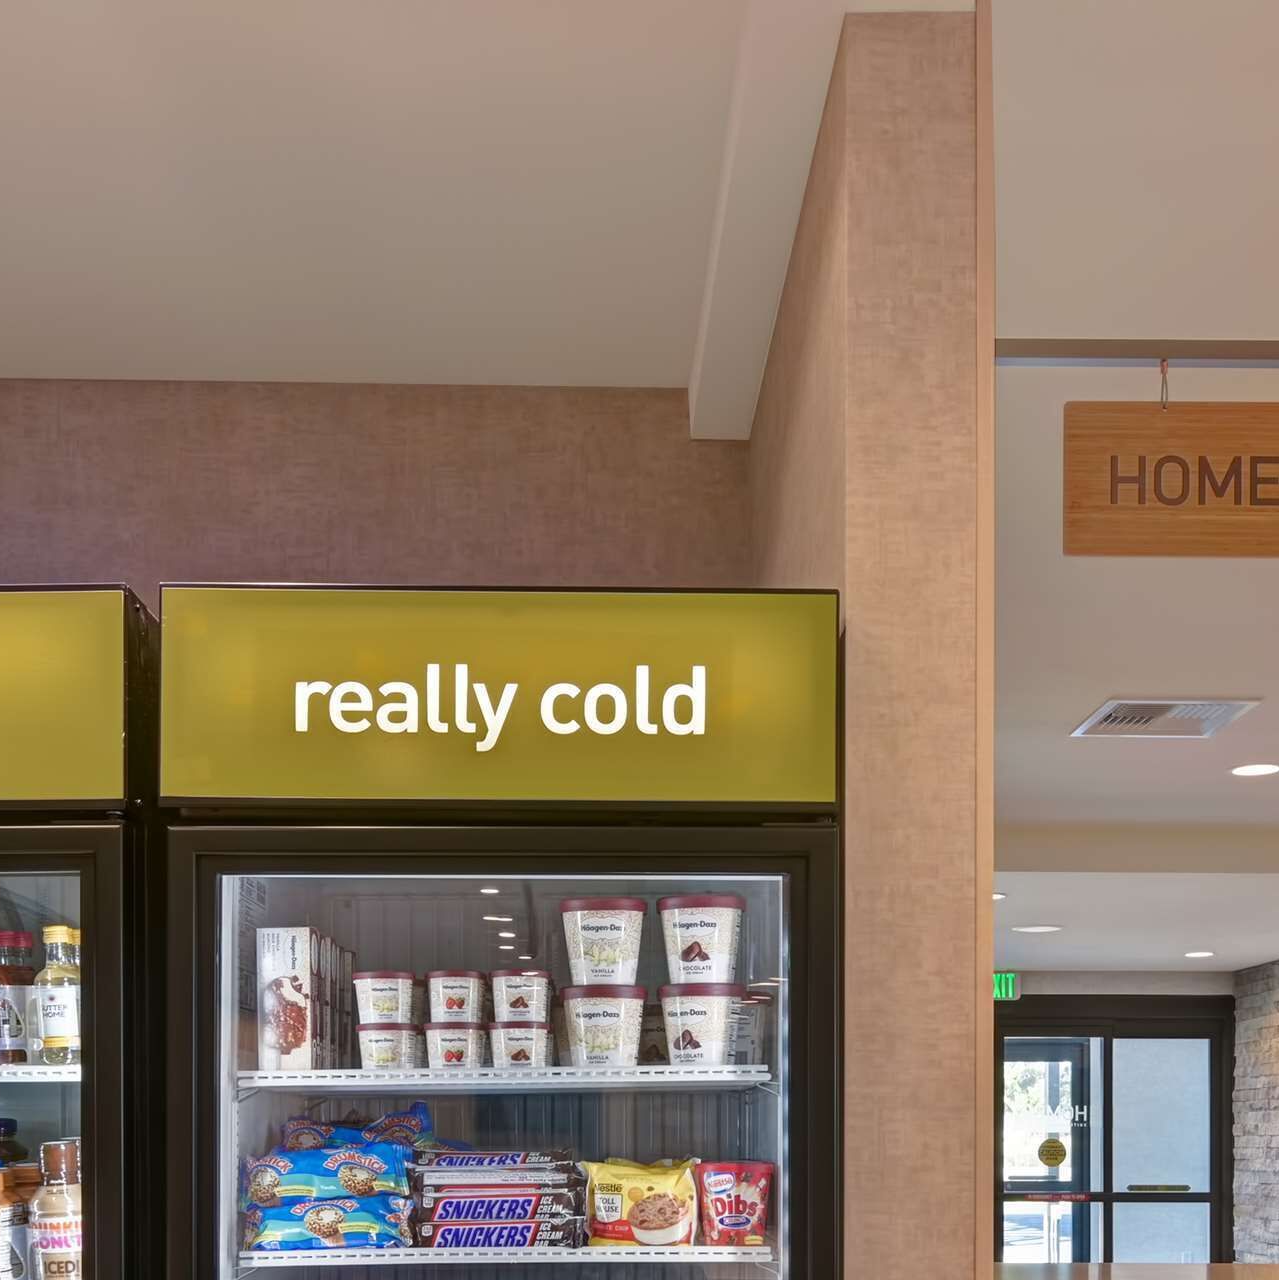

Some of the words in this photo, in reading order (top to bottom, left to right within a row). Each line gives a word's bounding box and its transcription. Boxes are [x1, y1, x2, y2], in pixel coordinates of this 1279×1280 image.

[294, 664, 518, 751] really
[539, 664, 708, 736] cold
[581, 923, 625, 932] Häagen-Daz
[992, 972, 1017, 999] XIT
[323, 1150, 388, 1173] DRUMSTICK
[438, 1198, 534, 1220] SNICKERS
[537, 1204, 563, 1213] CREAM
[540, 1196, 552, 1205] ICE
[711, 1193, 759, 1218] Dibs
[435, 1224, 532, 1247] SNICKERS
[536, 1231, 563, 1239] CREAM
[539, 1223, 552, 1231] ICE
[32, 1233, 82, 1250] DONUT
